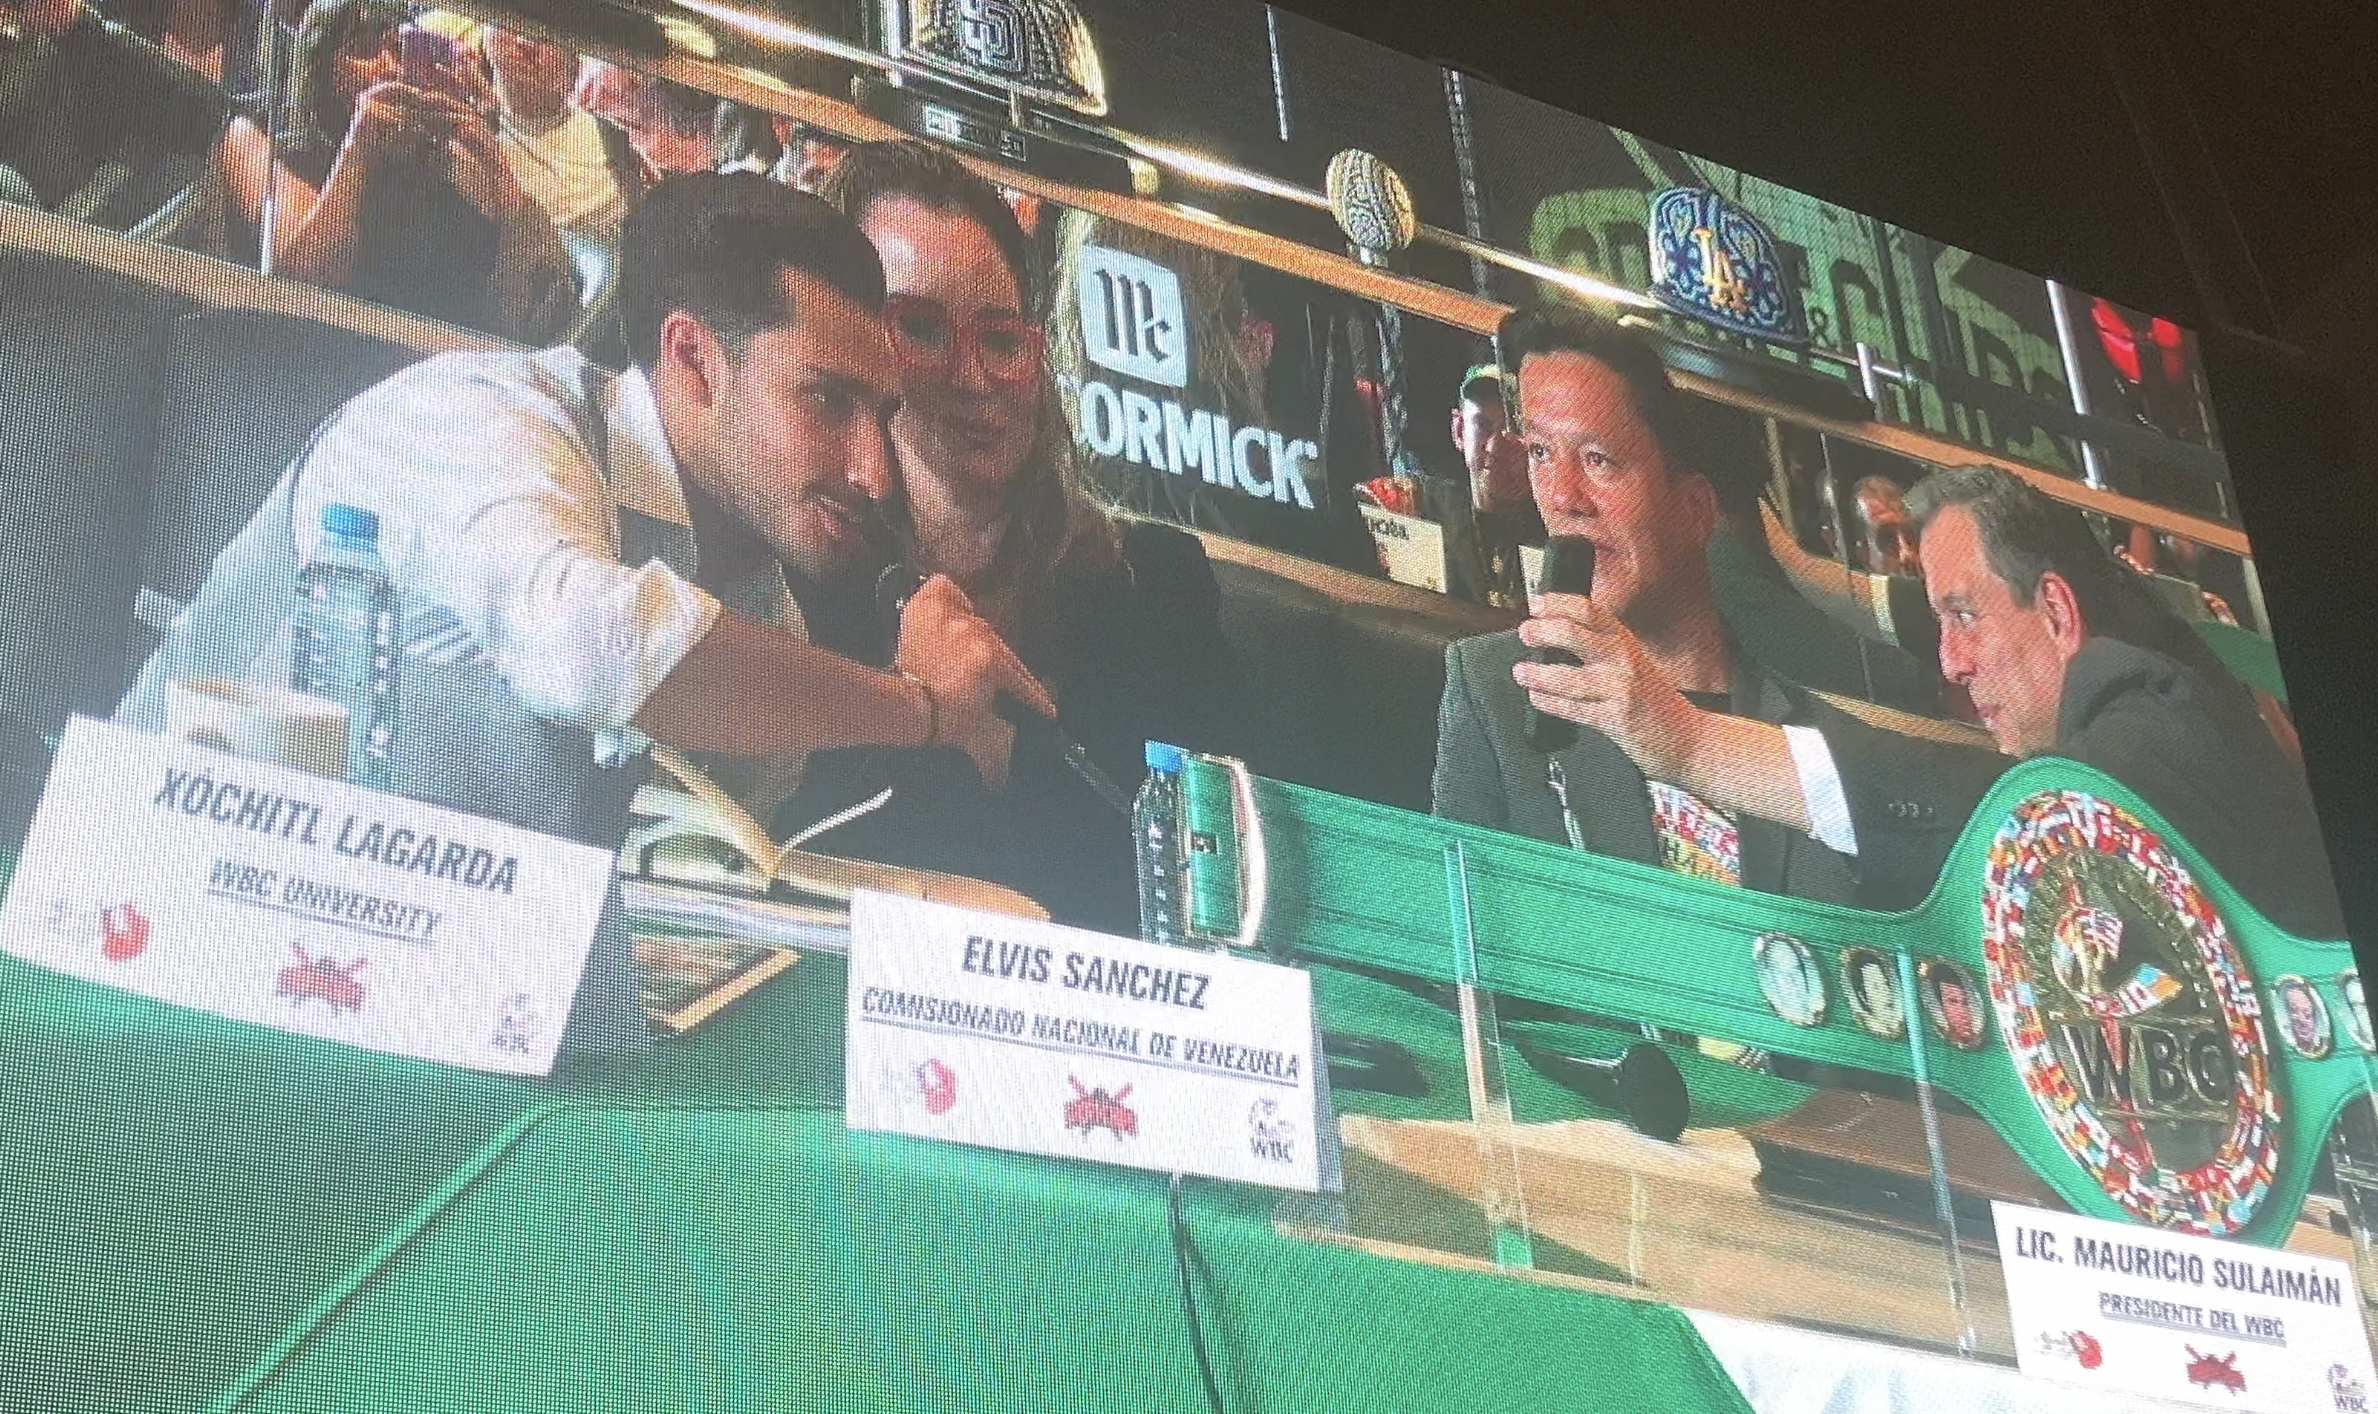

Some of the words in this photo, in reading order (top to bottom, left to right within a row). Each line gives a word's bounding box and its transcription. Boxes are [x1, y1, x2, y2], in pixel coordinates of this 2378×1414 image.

[1057, 373, 1318, 510] ORMICK
[155, 767, 321, 846] XÓCHITL
[333, 814, 520, 894] LAGARDA
[209, 858, 277, 898] WBC
[283, 875, 441, 934] UNIVERSITY
[962, 936, 1052, 984] ELVIS
[1062, 952, 1211, 1010] SANCHEZ
[862, 986, 1025, 1036] COMISIONADO
[1031, 1012, 1140, 1055] NACIONAL
[1149, 1031, 1176, 1058] DE
[1183, 1037, 1300, 1078] VENEZUELA
[2060, 1020, 2236, 1113] WBC
[1250, 1137, 1294, 1164] WBC
[2015, 1226, 2064, 1264] LIC.
[2074, 1236, 2204, 1286] MAURICIO
[2214, 1260, 2342, 1306] SULAIMÁN
[2098, 1291, 2204, 1327] PRESIDENTE
[2209, 1307, 2237, 1331] DEL
[2244, 1314, 2286, 1339] WBC
[2333, 1393, 2370, 1414] WBC
